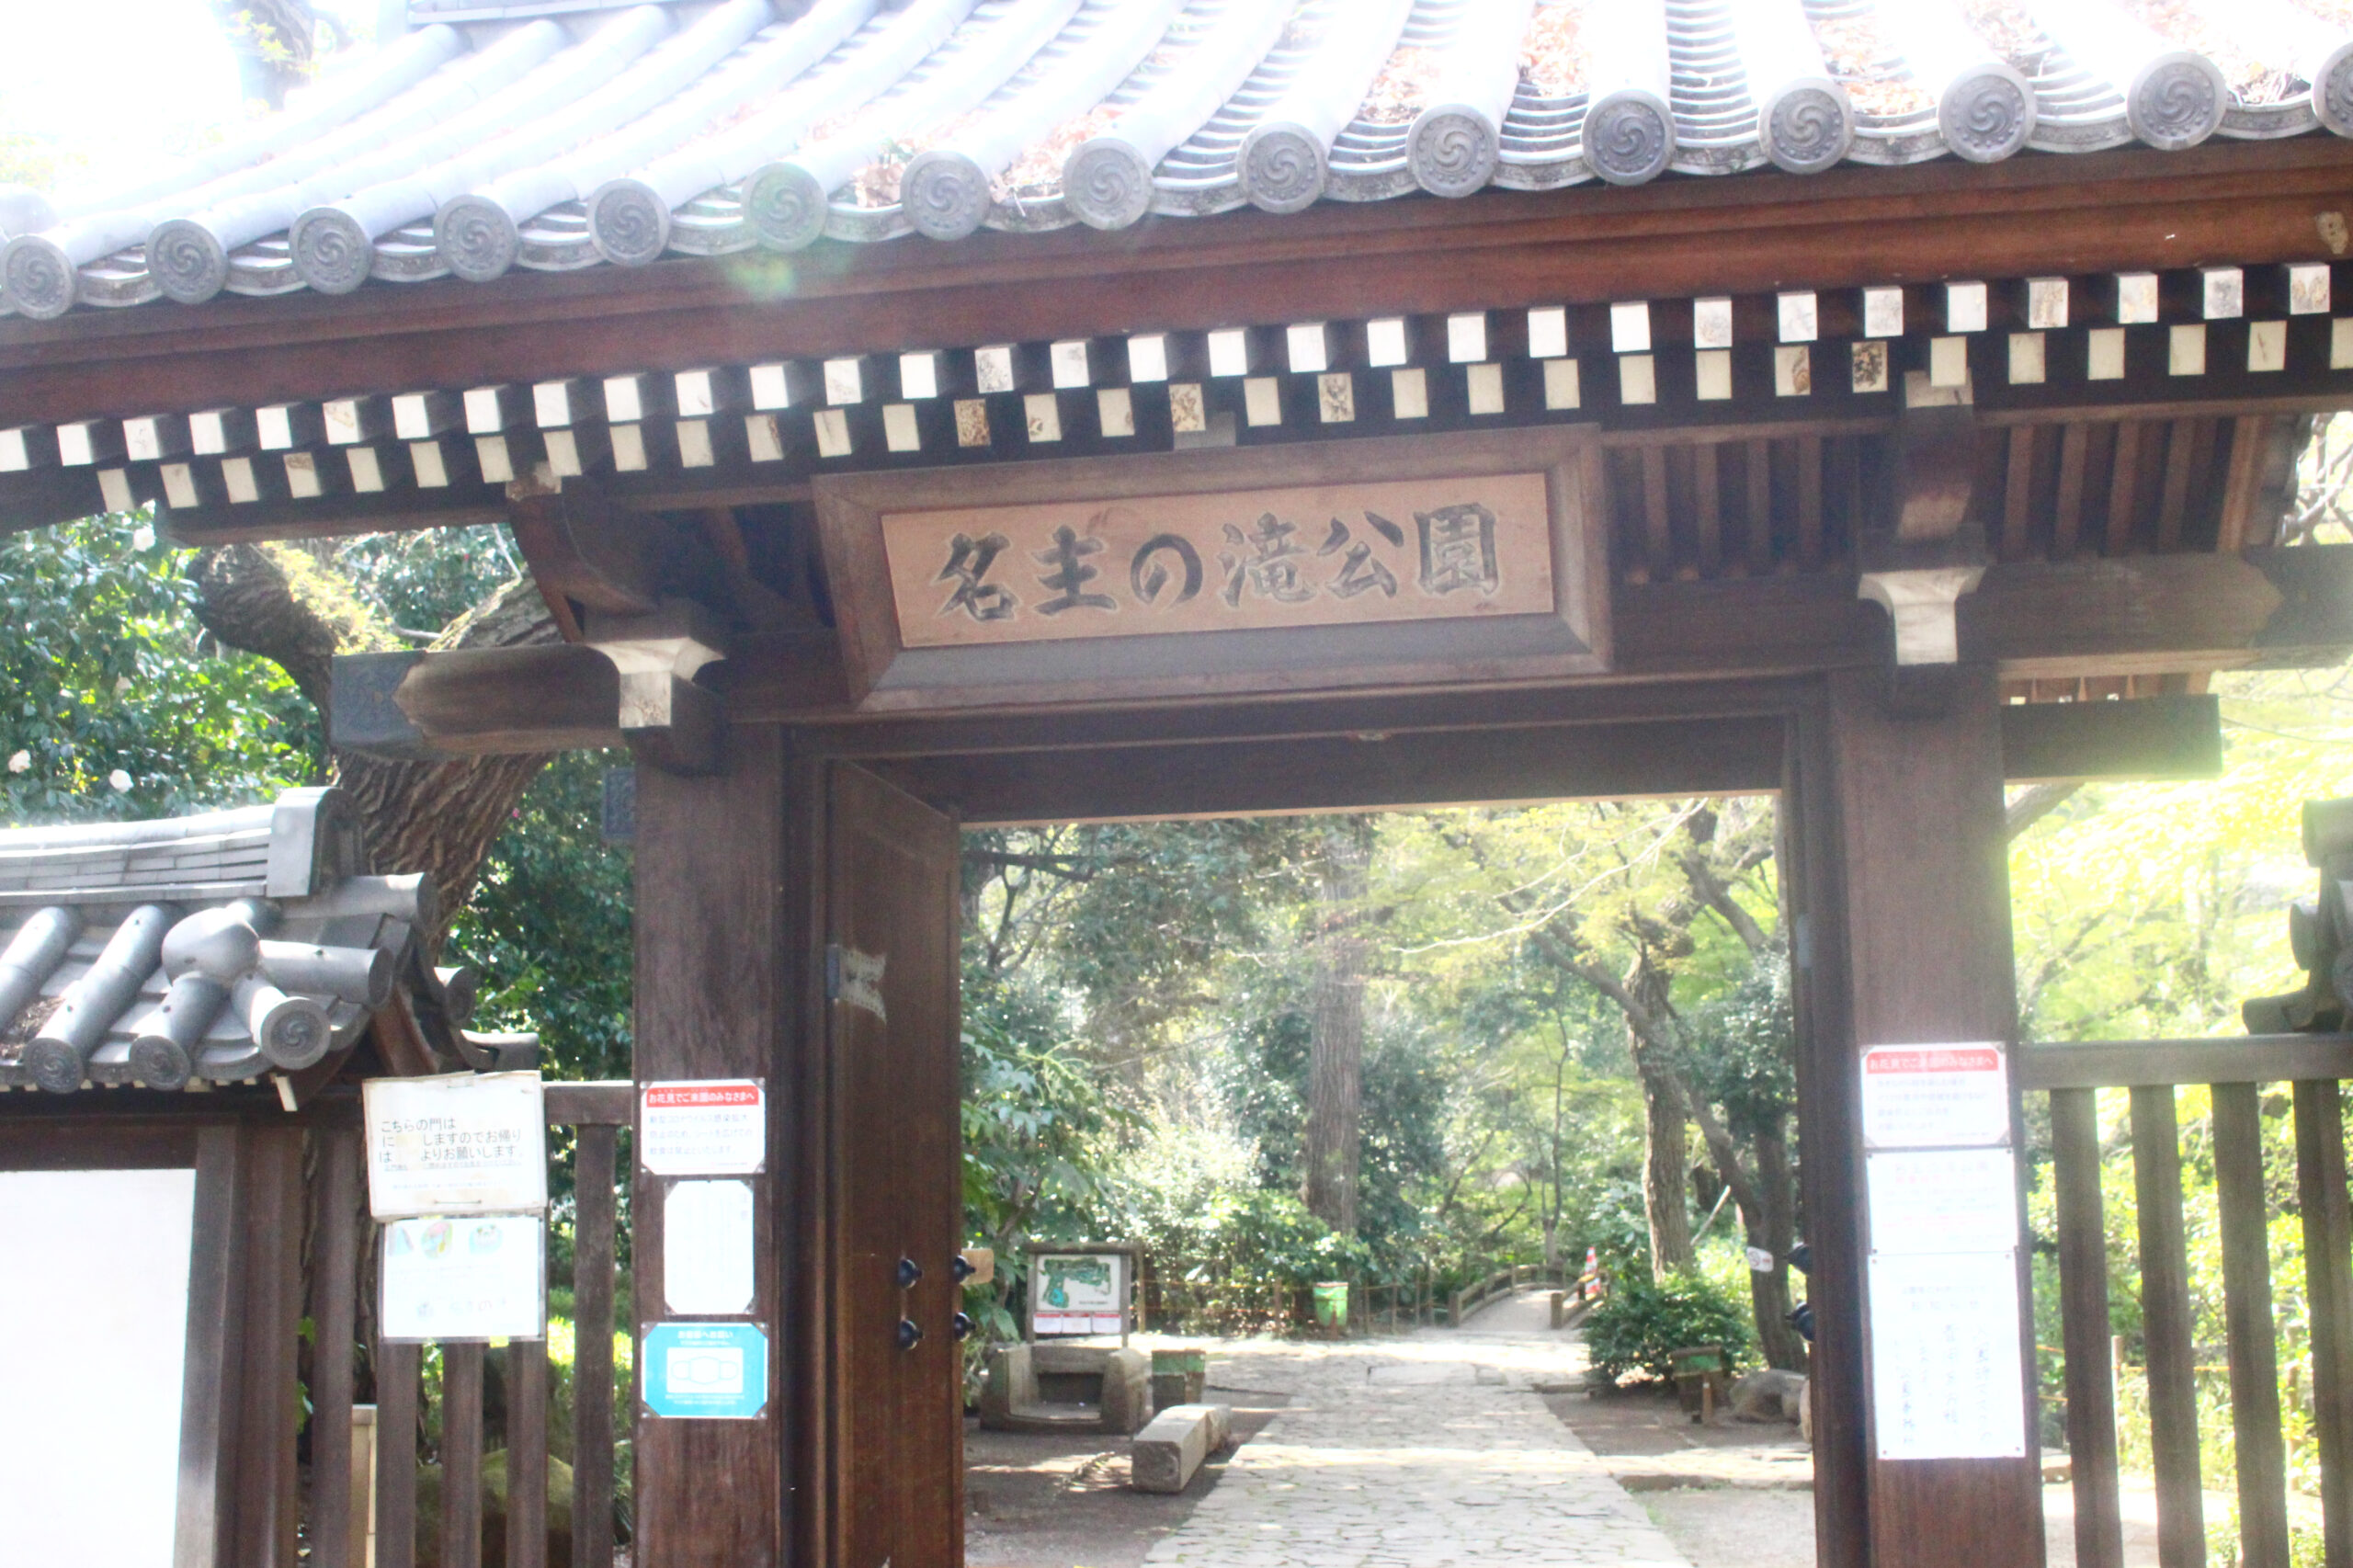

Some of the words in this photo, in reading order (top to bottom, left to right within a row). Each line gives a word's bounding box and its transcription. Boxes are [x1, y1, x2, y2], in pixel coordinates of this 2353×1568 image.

[932, 502, 1500, 623] 名主の滝公園
[381, 1117, 456, 1133] こちらの門は
[422, 1128, 522, 1148] しますのでお帰り
